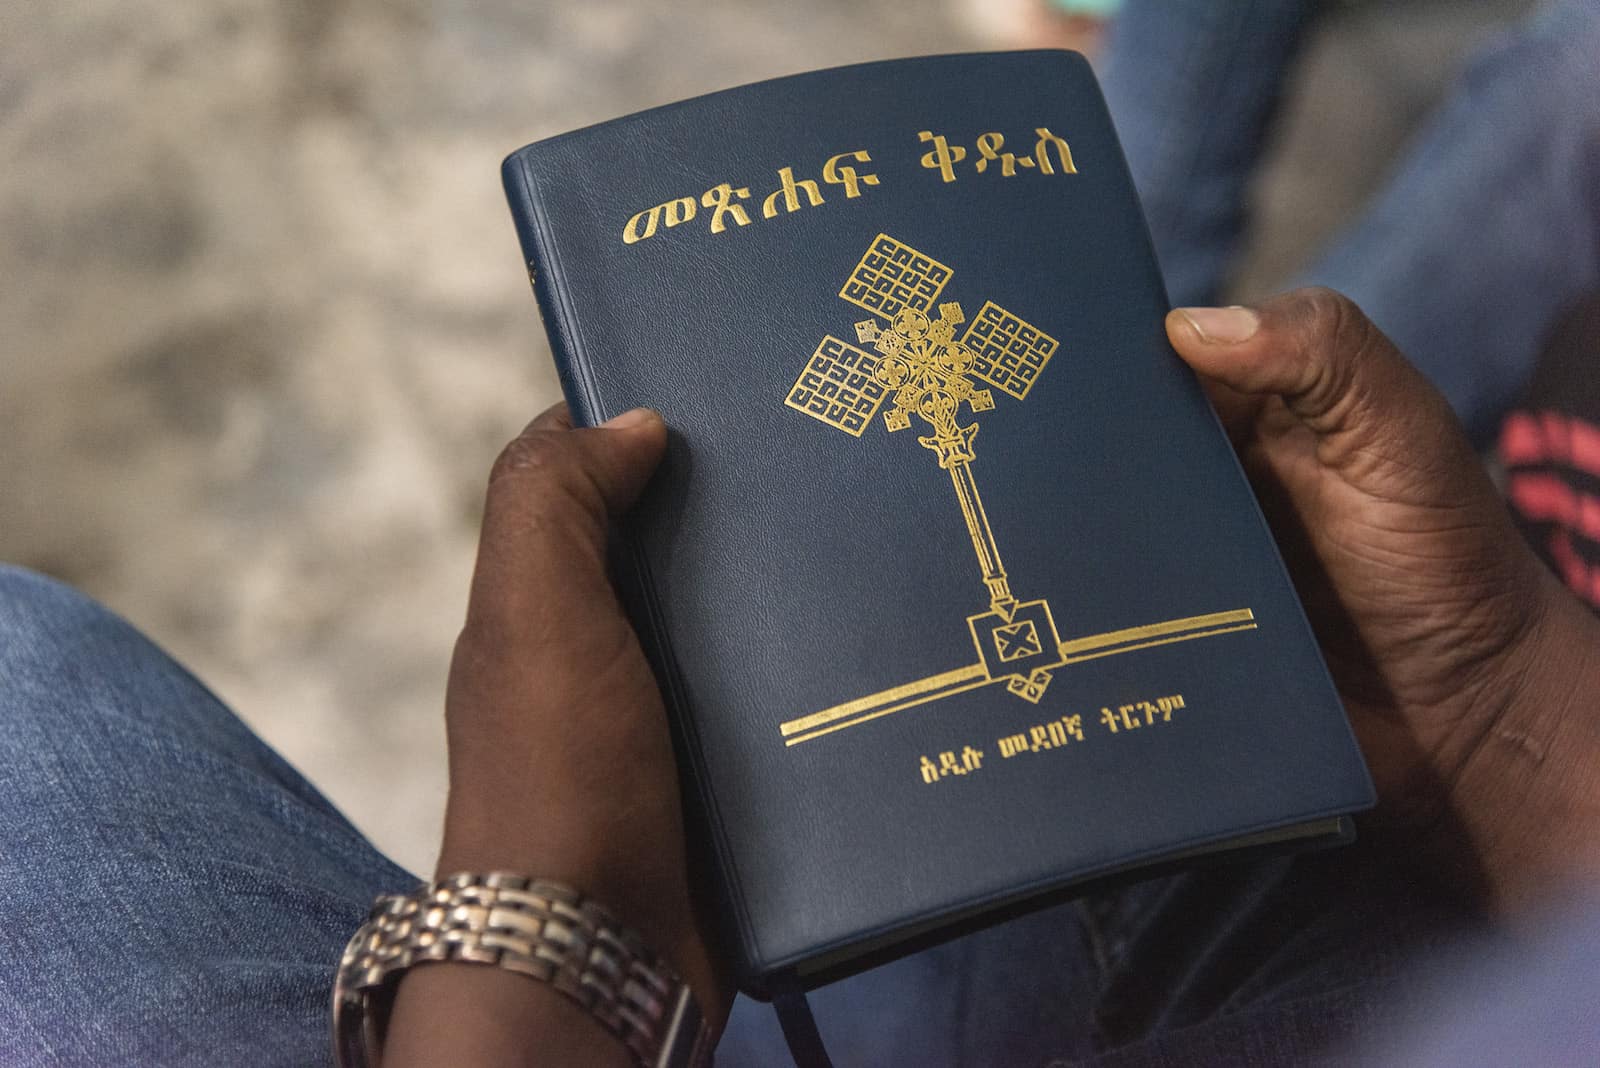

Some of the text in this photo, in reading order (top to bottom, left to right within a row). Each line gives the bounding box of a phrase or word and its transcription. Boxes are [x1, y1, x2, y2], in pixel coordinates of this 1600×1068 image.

[622, 127, 1078, 244] መጽሐፍ ቅዱስ
[919, 694, 1186, 784] አዲሱ መደበኛ ትርጉም
